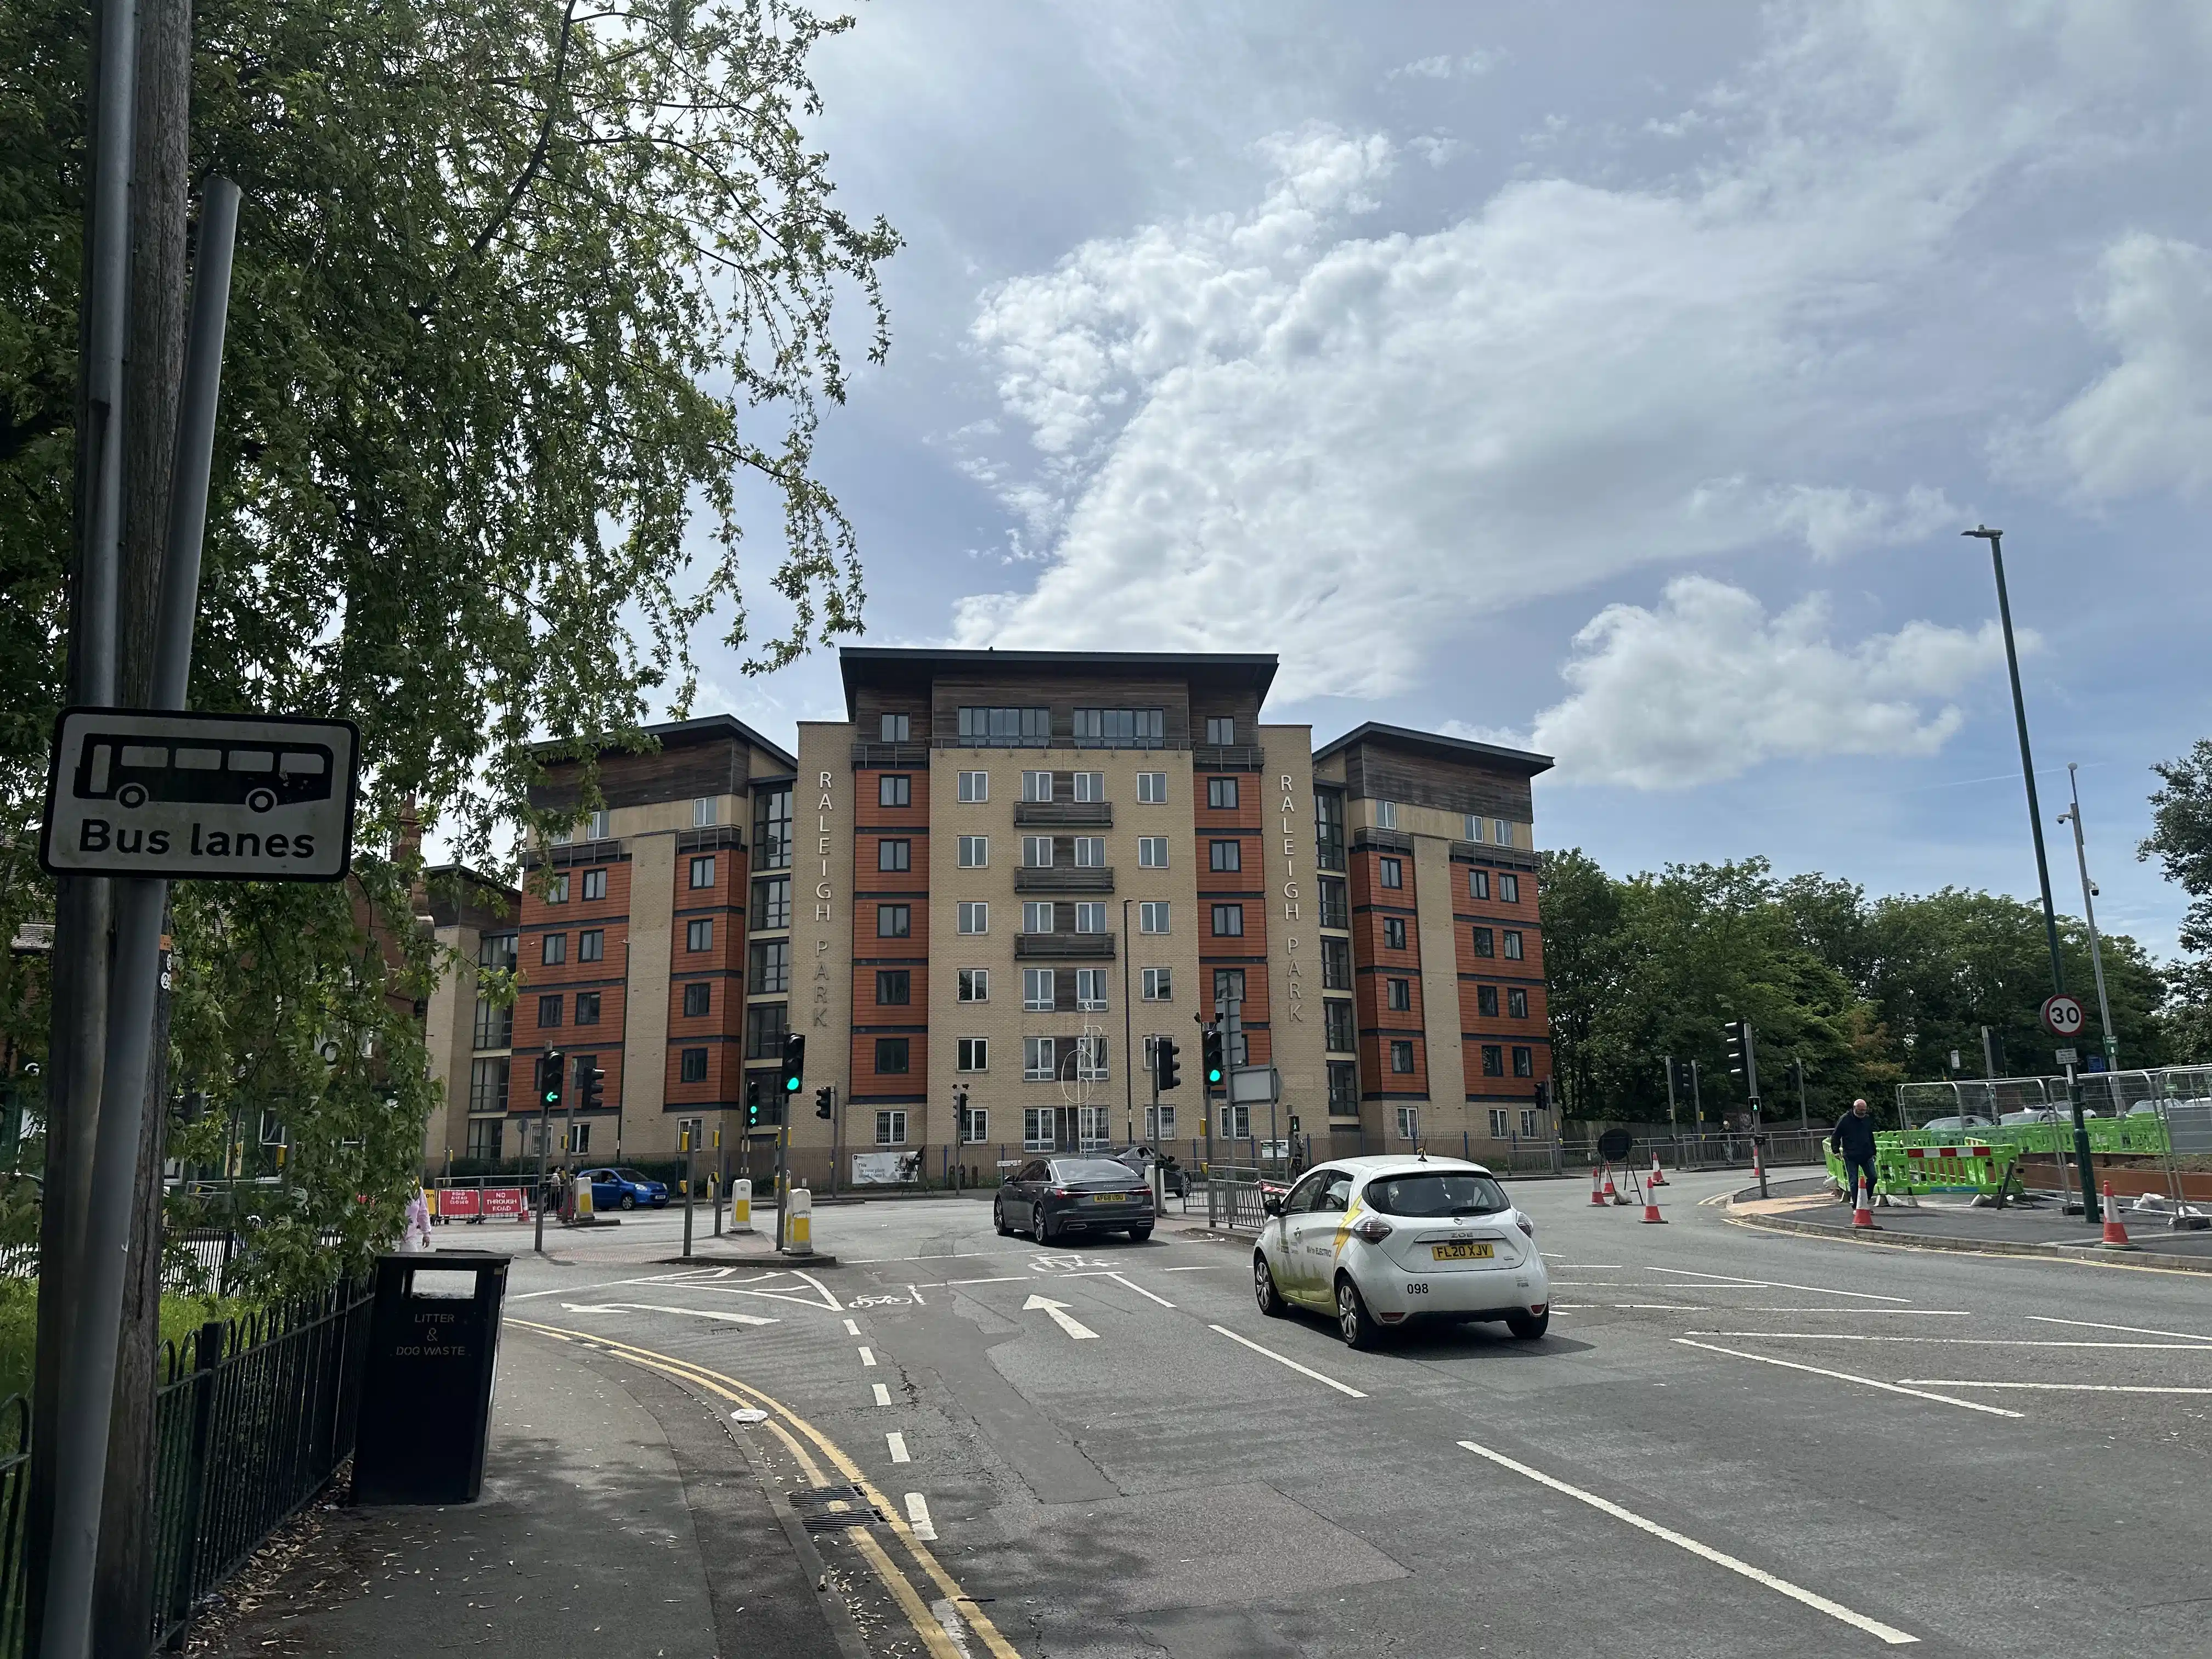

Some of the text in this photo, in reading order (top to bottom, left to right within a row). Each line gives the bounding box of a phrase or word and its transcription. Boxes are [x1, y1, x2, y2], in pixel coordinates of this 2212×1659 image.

[79, 819, 315, 859] Bus lanes
[814, 771, 833, 1026] RALEIGH PARK
[1280, 775, 1303, 1022] RALEIGH PARK
[2051, 1007, 2079, 1024] 30
[1437, 1245, 1488, 1258] FL20 XJV
[1407, 1283, 1429, 1294] 098
[414, 1313, 455, 1323] LITTER
[426, 1328, 438, 1341] &
[396, 1346, 466, 1356] DOG WASTE
